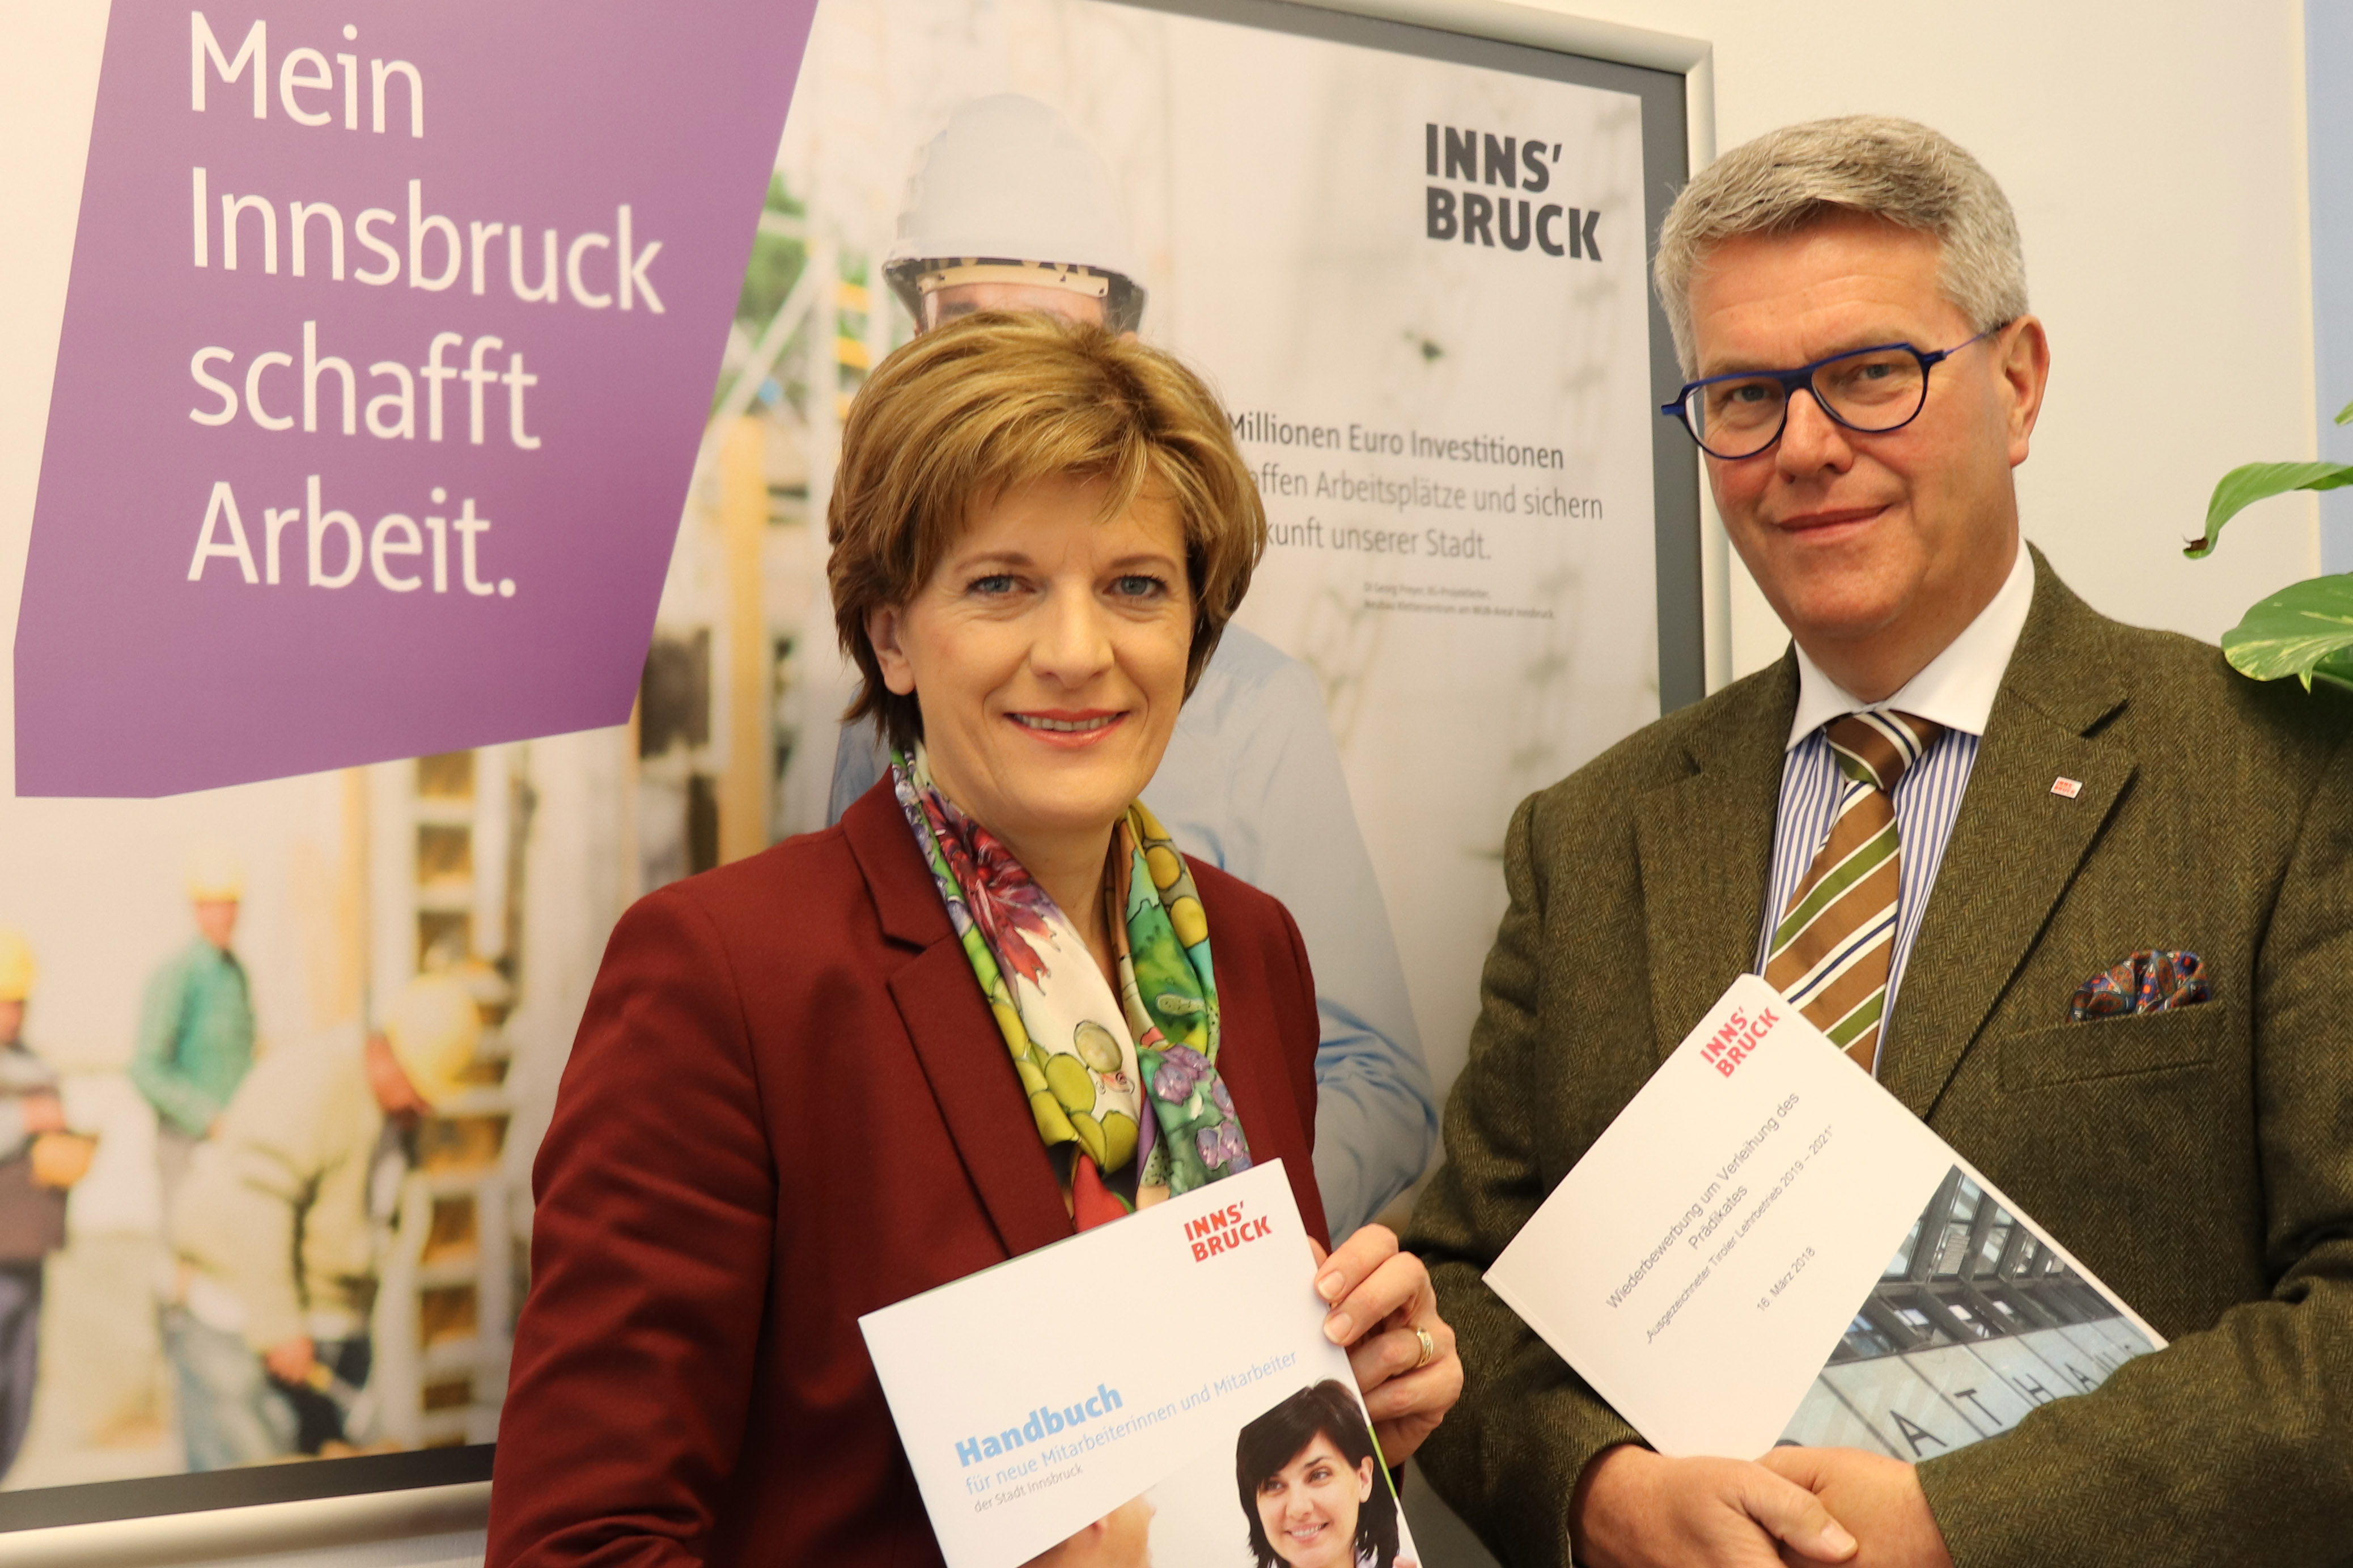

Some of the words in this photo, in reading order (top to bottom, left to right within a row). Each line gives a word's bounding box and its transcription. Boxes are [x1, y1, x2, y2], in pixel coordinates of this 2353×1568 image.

[191, 10, 424, 138] Mein
[1426, 122, 1563, 194] INNS'
[192, 166, 665, 314] Innsbruck
[1427, 185, 1602, 262] BRUCK
[189, 320, 541, 449] schafft
[1227, 411, 1340, 449] Millionen
[1350, 424, 1404, 455] Euro
[1411, 430, 1564, 470] Investitionen
[1315, 470, 1466, 513] Arbeitsplätze
[1474, 483, 1516, 513] und
[1523, 486, 1603, 520] sichern
[187, 474, 516, 598] Arbeit.
[1332, 527, 1418, 555] unserer
[1425, 528, 1492, 560] Stadt.
[1700, 1005, 1747, 1064] INNS'
[1715, 1006, 1780, 1078] BRUCK
[1184, 1200, 1244, 1242] INNS'
[1606, 1202, 1704, 1309] Wiederbewerbung
[1702, 1180, 1721, 1204] um
[1716, 1116, 1779, 1182] Verleihung
[1776, 1092, 1800, 1119] des
[1687, 1184, 1748, 1250] Prädikates
[1708, 1235, 1737, 1267] Tiroler
[1734, 1185, 1783, 1238] Lehrbetrieb
[1779, 1159, 1804, 1187] 2019
[1191, 1214, 1272, 1263] BRUCK
[1770, 1273, 1795, 1298] März
[1791, 1245, 1815, 1273] 2018
[955, 1383, 1123, 1468] Handbuch
[965, 1473, 991, 1495] für
[995, 1459, 1038, 1485] neue
[1041, 1402, 1177, 1467] Mitarbeiterinnen
[1180, 1383, 1211, 1411] und
[1213, 1350, 1297, 1397] Mitarbeiter
[974, 1498, 993, 1513] der
[994, 1485, 1027, 1506] Stadt
[1027, 1463, 1084, 1493] Innsbruck
